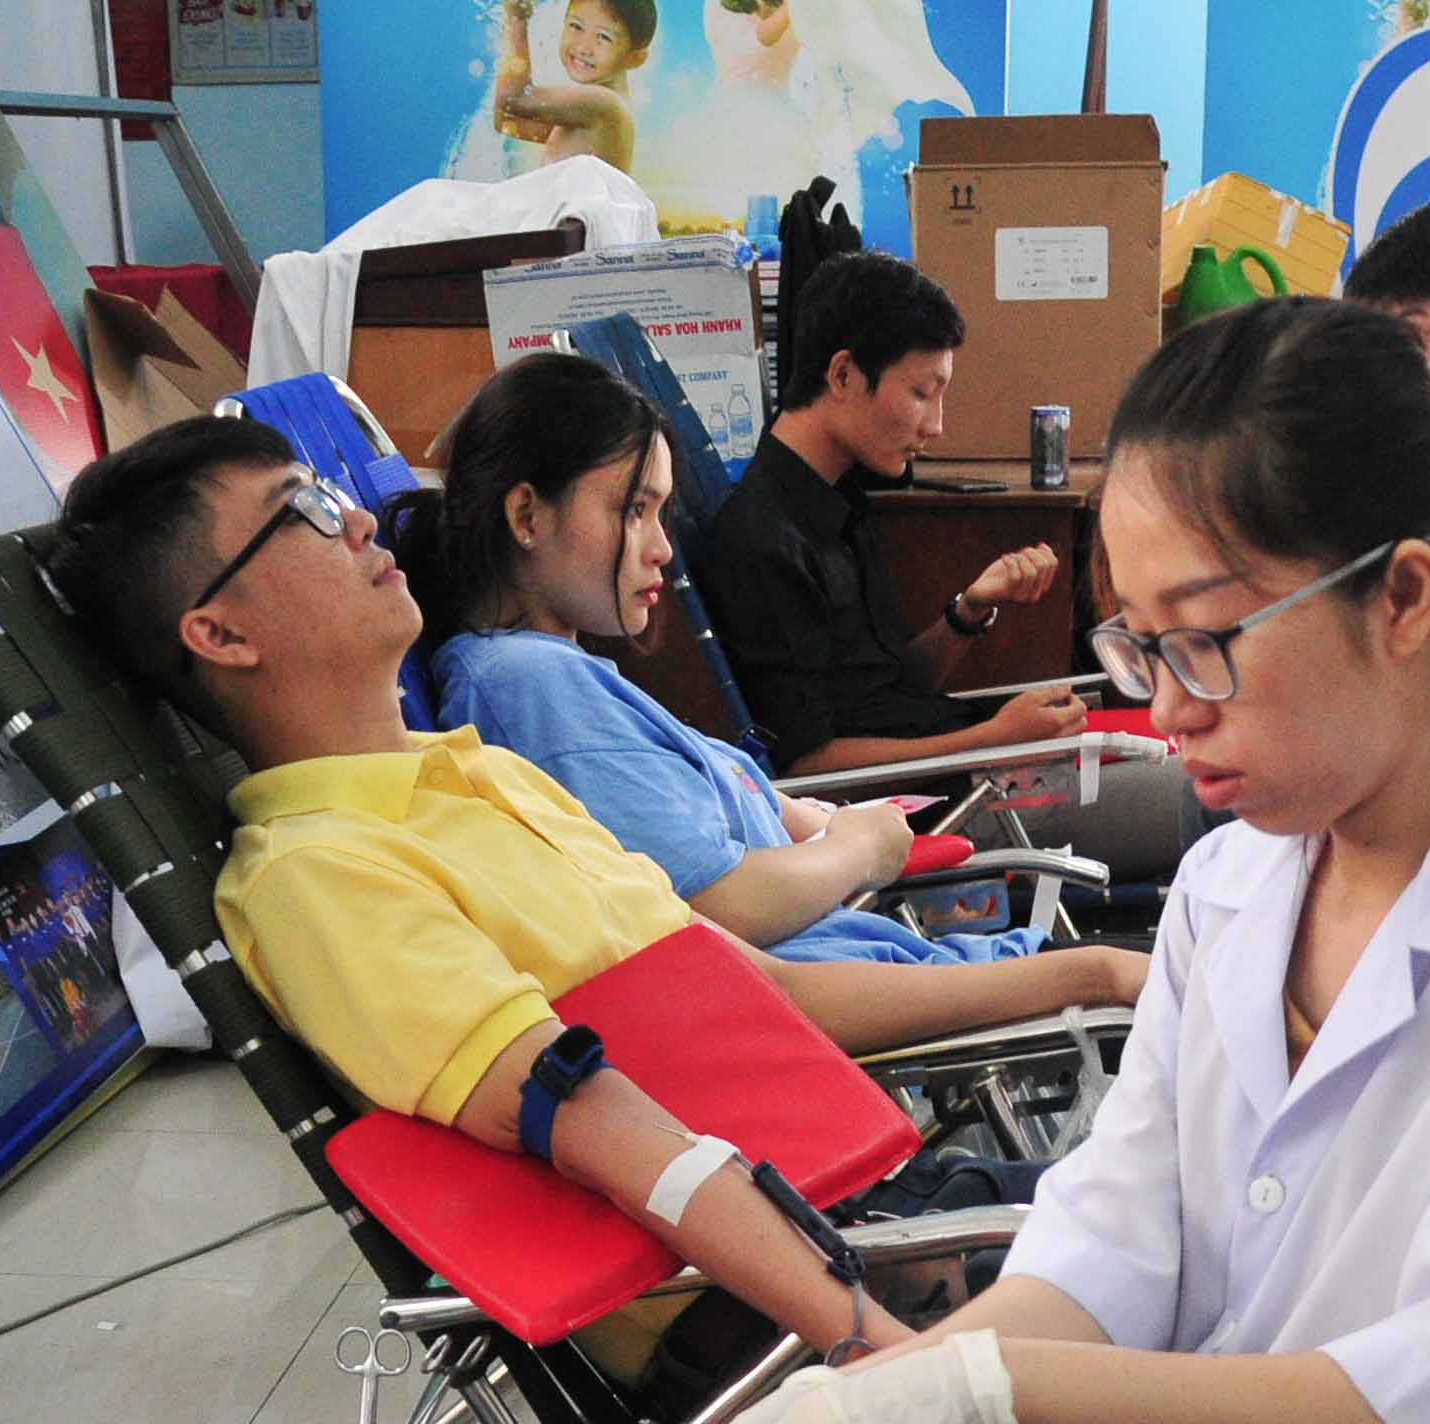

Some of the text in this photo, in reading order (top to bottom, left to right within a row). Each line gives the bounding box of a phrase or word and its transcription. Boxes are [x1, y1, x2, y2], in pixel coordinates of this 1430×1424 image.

[594, 252, 635, 266] Sanna
[666, 248, 706, 262] Sanna
[675, 322, 699, 336] HOA
[702, 319, 743, 333] KHANH
[508, 333, 554, 350] OMPANY
